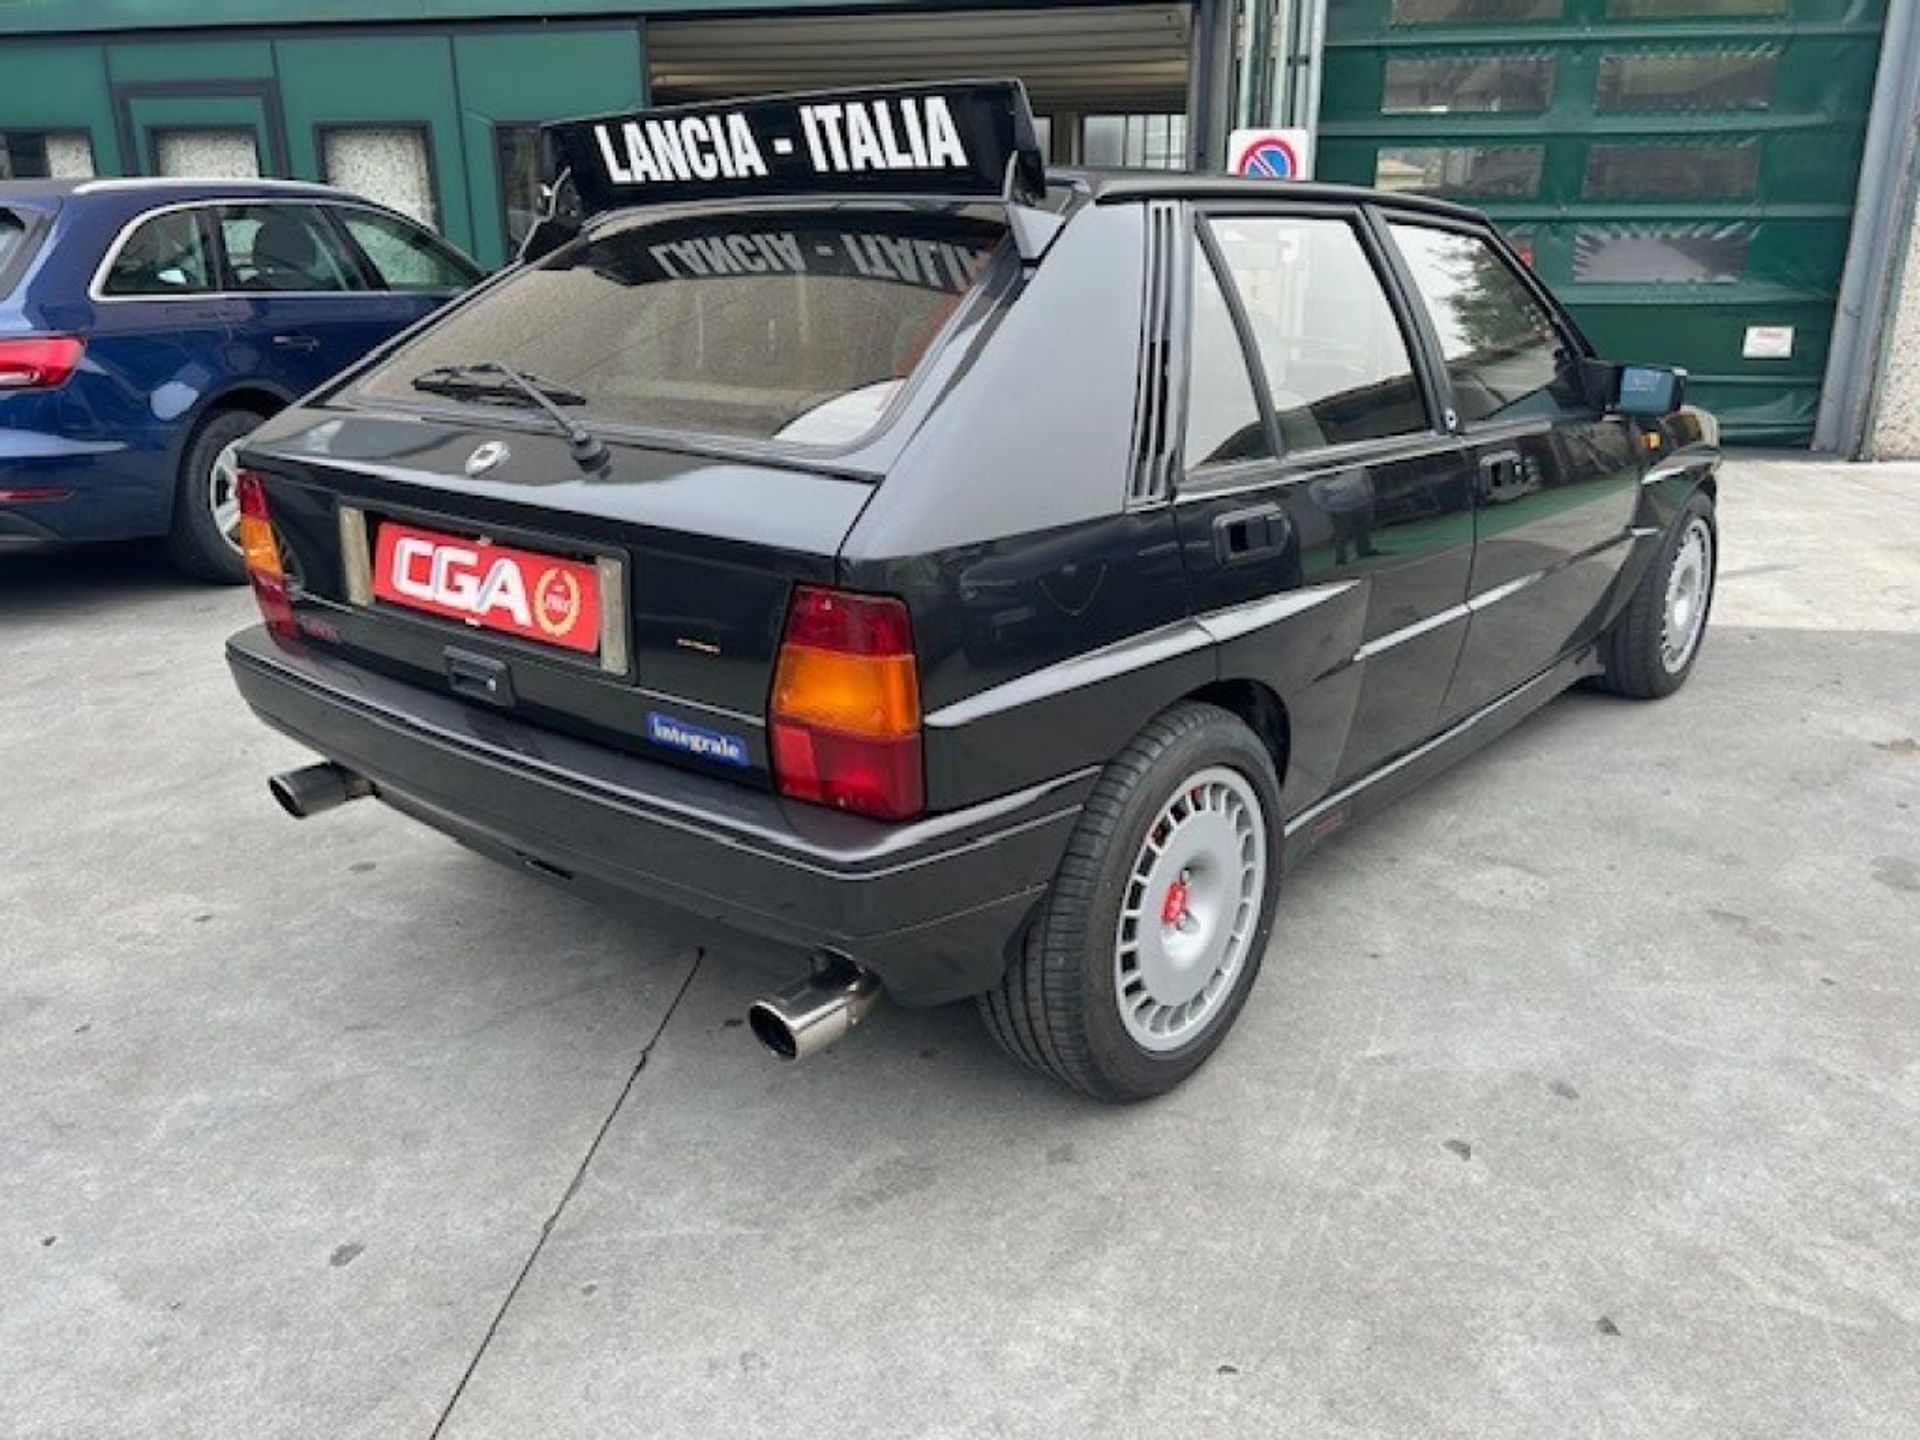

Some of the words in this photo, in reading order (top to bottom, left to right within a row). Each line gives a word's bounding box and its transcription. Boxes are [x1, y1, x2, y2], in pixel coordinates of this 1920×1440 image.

[594, 112, 769, 184] LANCIA
[799, 95, 968, 173] ITALIA
[391, 536, 533, 627] CGA
[652, 715, 741, 759] integrale
